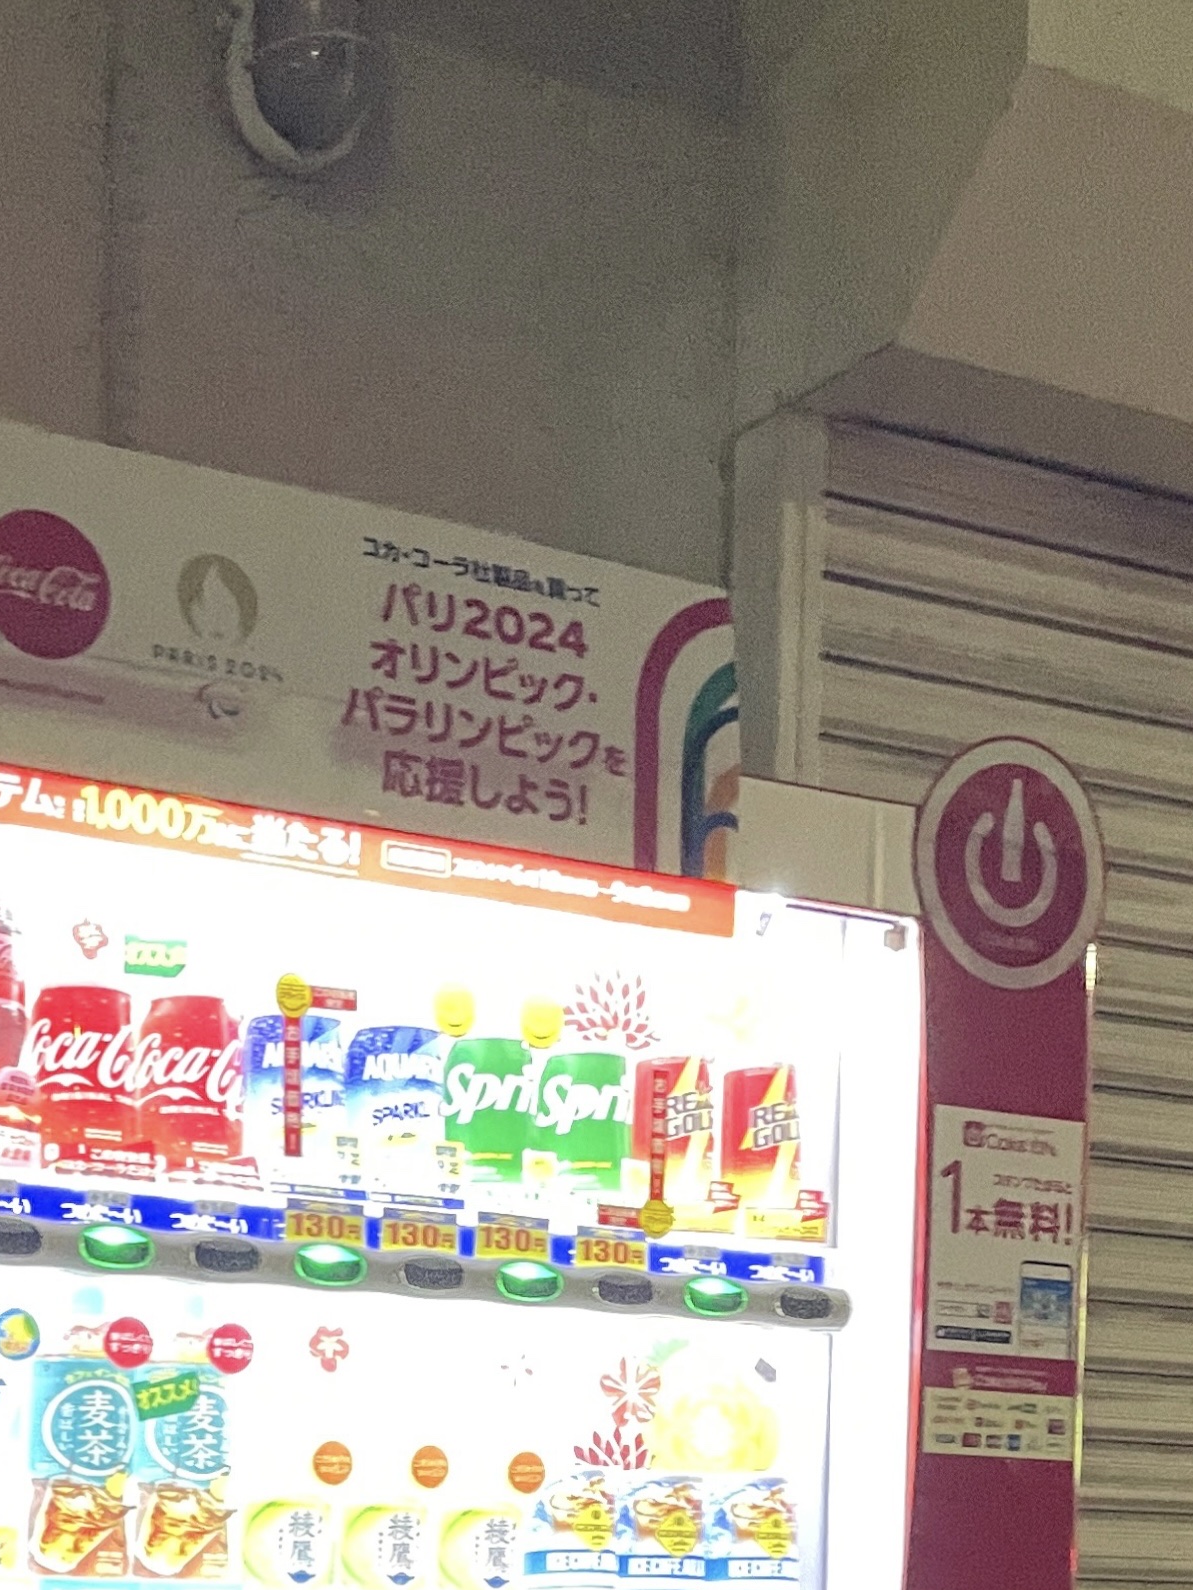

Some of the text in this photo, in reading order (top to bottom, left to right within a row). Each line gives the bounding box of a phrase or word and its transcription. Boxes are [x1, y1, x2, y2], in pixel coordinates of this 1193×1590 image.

[381, 582, 588, 658] パリ2024
[152, 643, 285, 683] PARIS 2024
[341, 686, 627, 778] パラリンピックを
[76, 1389, 117, 1467] 麦茶
[181, 1393, 225, 1470] 麦茶
